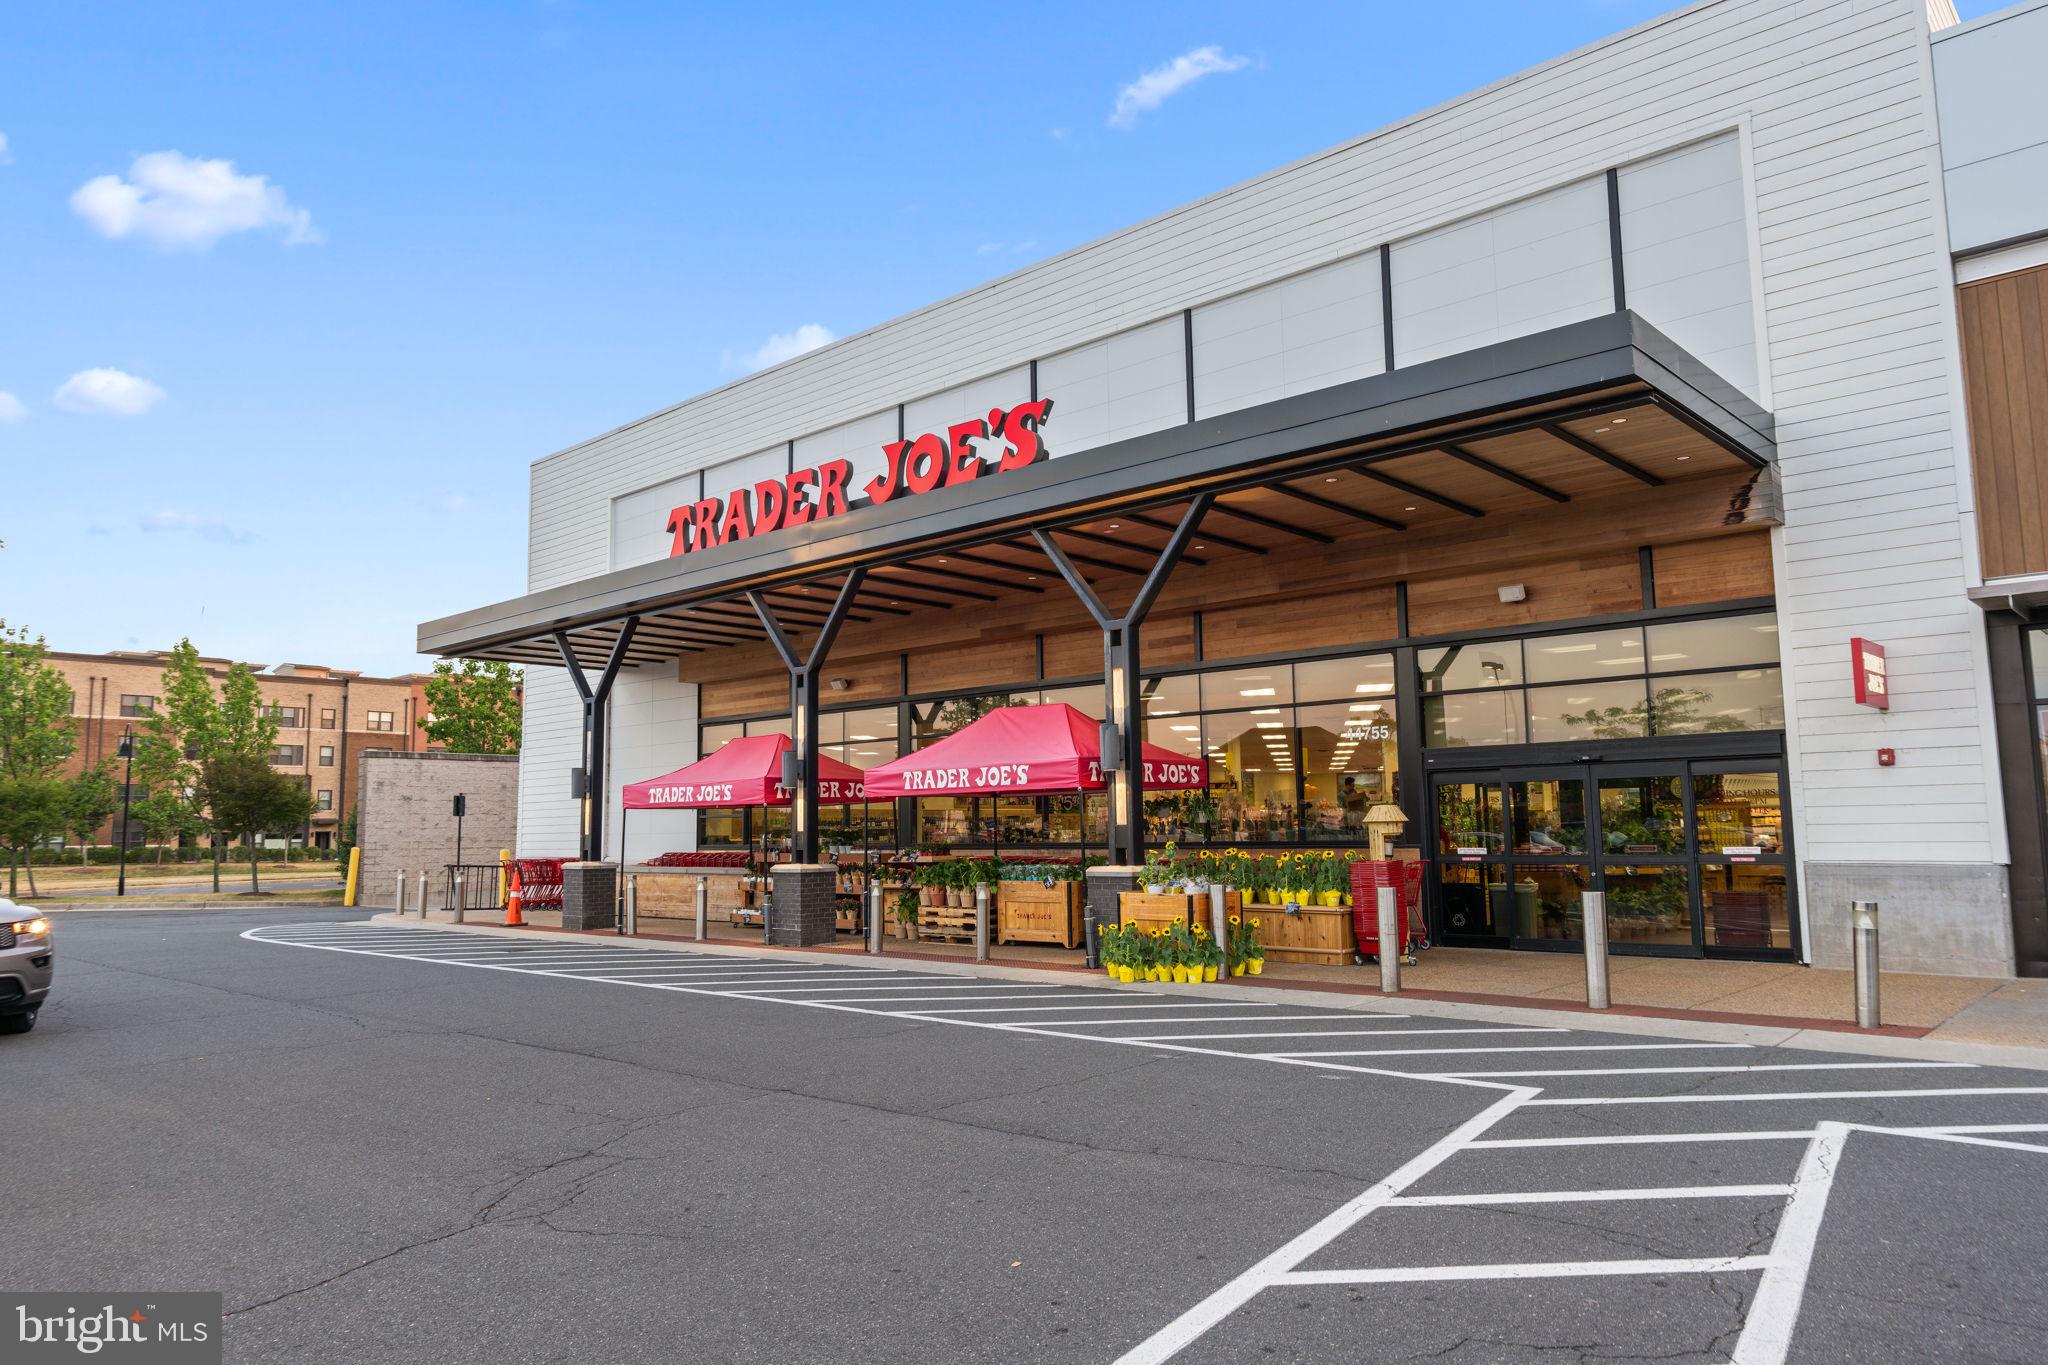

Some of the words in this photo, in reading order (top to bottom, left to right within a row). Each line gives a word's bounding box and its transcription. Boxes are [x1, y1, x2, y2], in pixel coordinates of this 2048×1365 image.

[666, 459, 854, 558] TRADER
[863, 398, 1054, 507] JOE'S
[1344, 725, 1389, 740] 44755
[903, 768, 970, 790] TRADER
[975, 764, 1029, 787] JOE'S
[1158, 763, 1200, 784] JOE'S
[648, 785, 693, 803] TRADER
[697, 784, 732, 801] JOE'S
